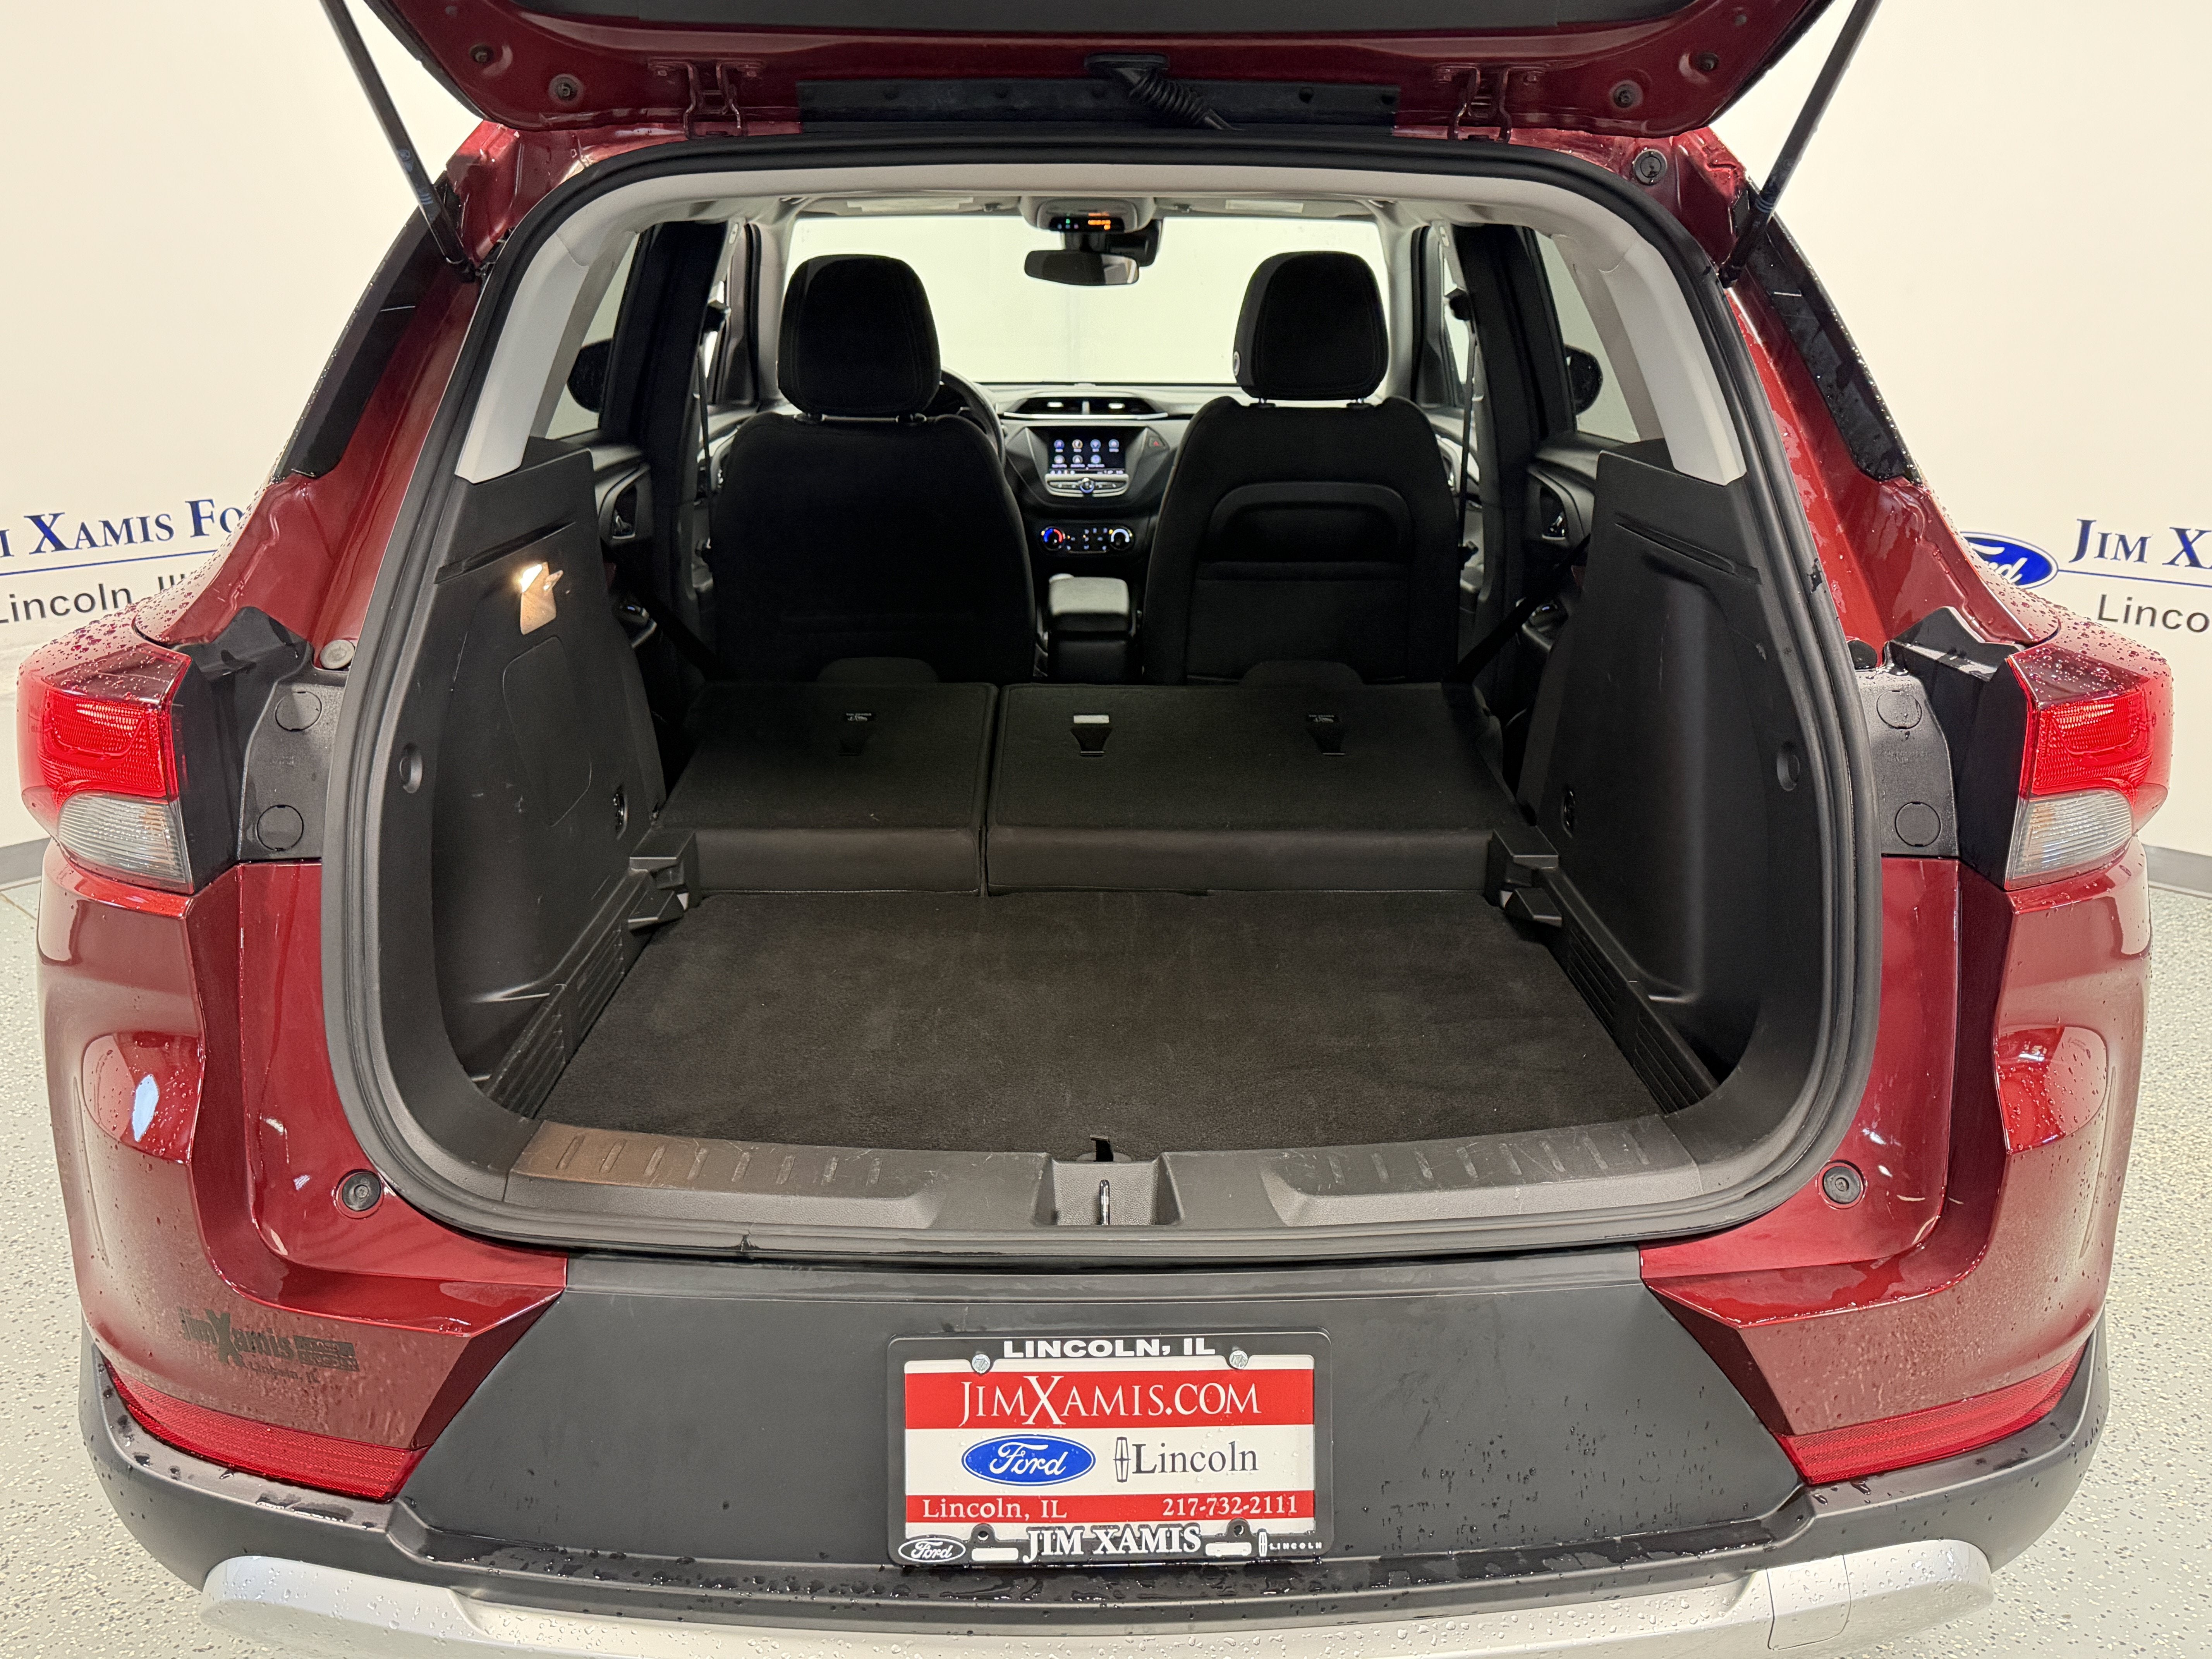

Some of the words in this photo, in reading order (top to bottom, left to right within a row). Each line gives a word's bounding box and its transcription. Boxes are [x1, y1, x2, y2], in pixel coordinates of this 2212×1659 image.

[2162, 527, 2212, 569] X
[0, 584, 132, 623] incoln
[1004, 1339, 1171, 1358] LINCOLN,
[1183, 1338, 1216, 1355] IL
[989, 1442, 1068, 1475] Ford
[1132, 1441, 1258, 1474] Lincoln
[923, 1498, 1029, 1521] Lincoln,
[1041, 1500, 1067, 1518] IL
[1163, 1495, 1297, 1516] 217-732-2111
[911, 1541, 953, 1559] Ford
[1022, 1529, 1084, 1563] JIM
[1092, 1525, 1201, 1555] XAMIS
